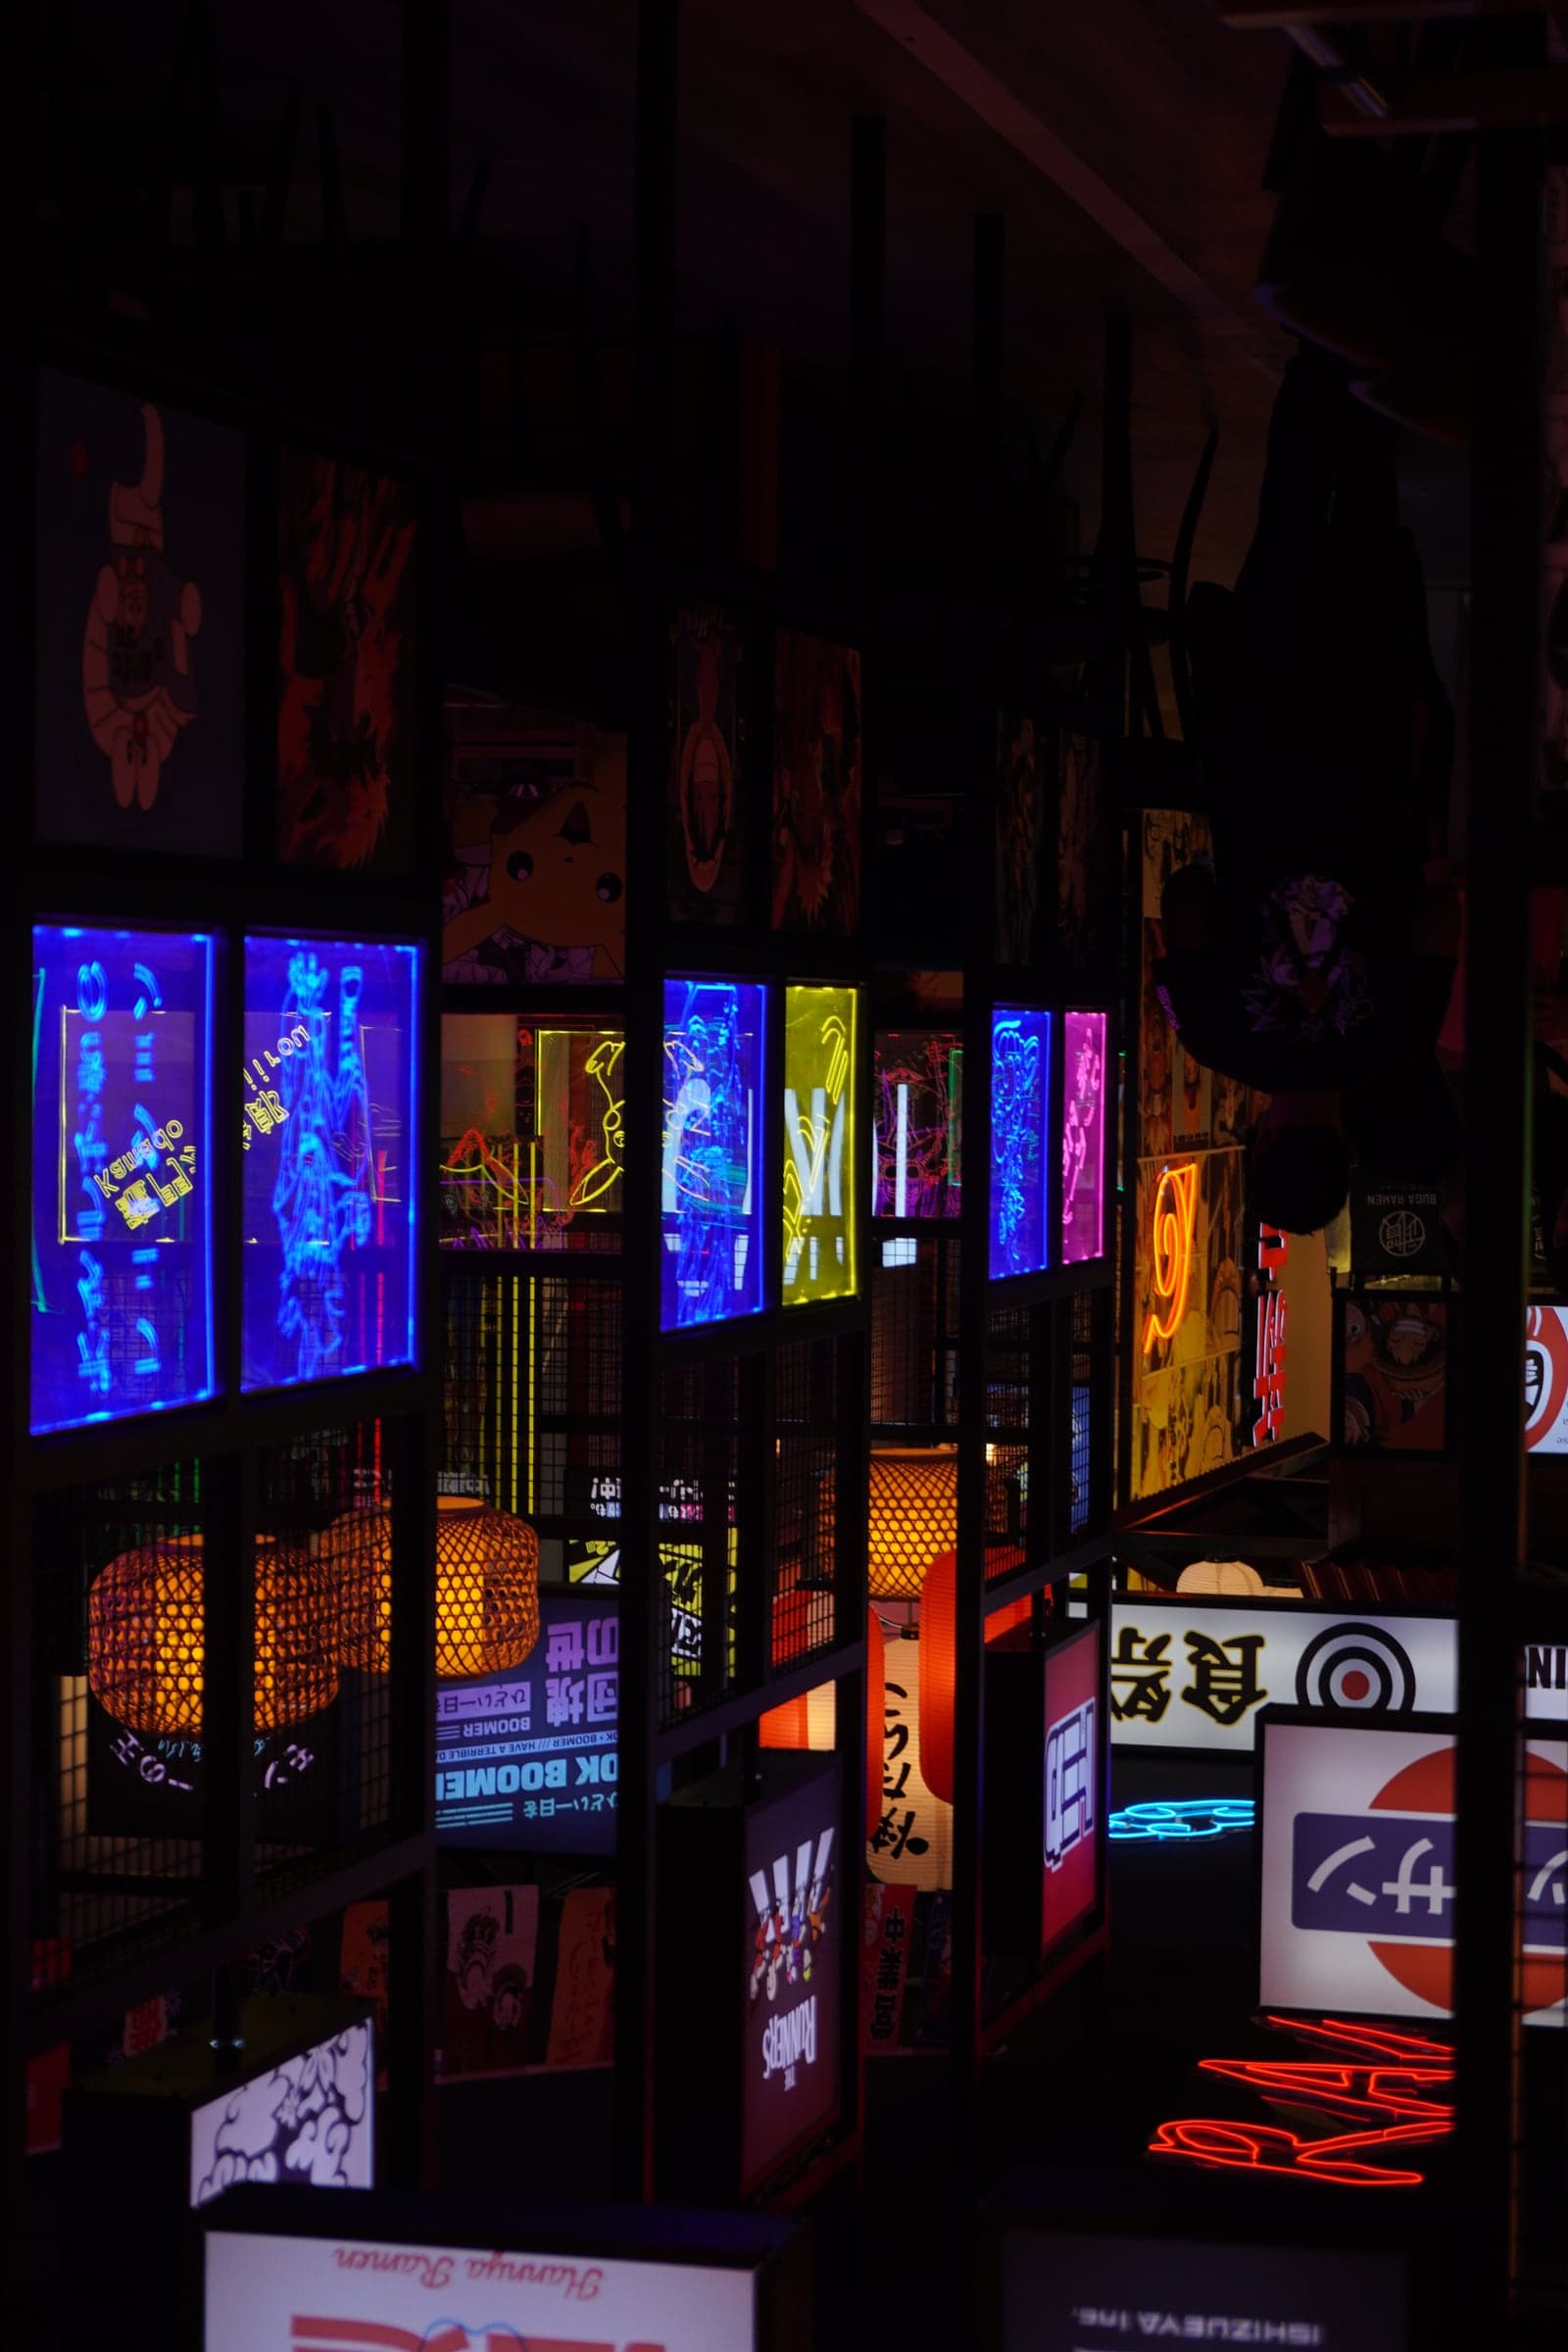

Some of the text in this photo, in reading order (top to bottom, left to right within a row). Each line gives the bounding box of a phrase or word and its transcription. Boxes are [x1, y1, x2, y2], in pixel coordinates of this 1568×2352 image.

[1366, 1194, 1404, 1205] RAMEN
[462, 1716, 531, 1738] BOOMER
[509, 1741, 535, 1752] HAVE
[553, 1734, 597, 1747] BOOMER
[449, 1746, 495, 1759] TERRIBLE
[761, 1994, 818, 2080] RUNNERS
[332, 2248, 604, 2301] Hannya Ramen
